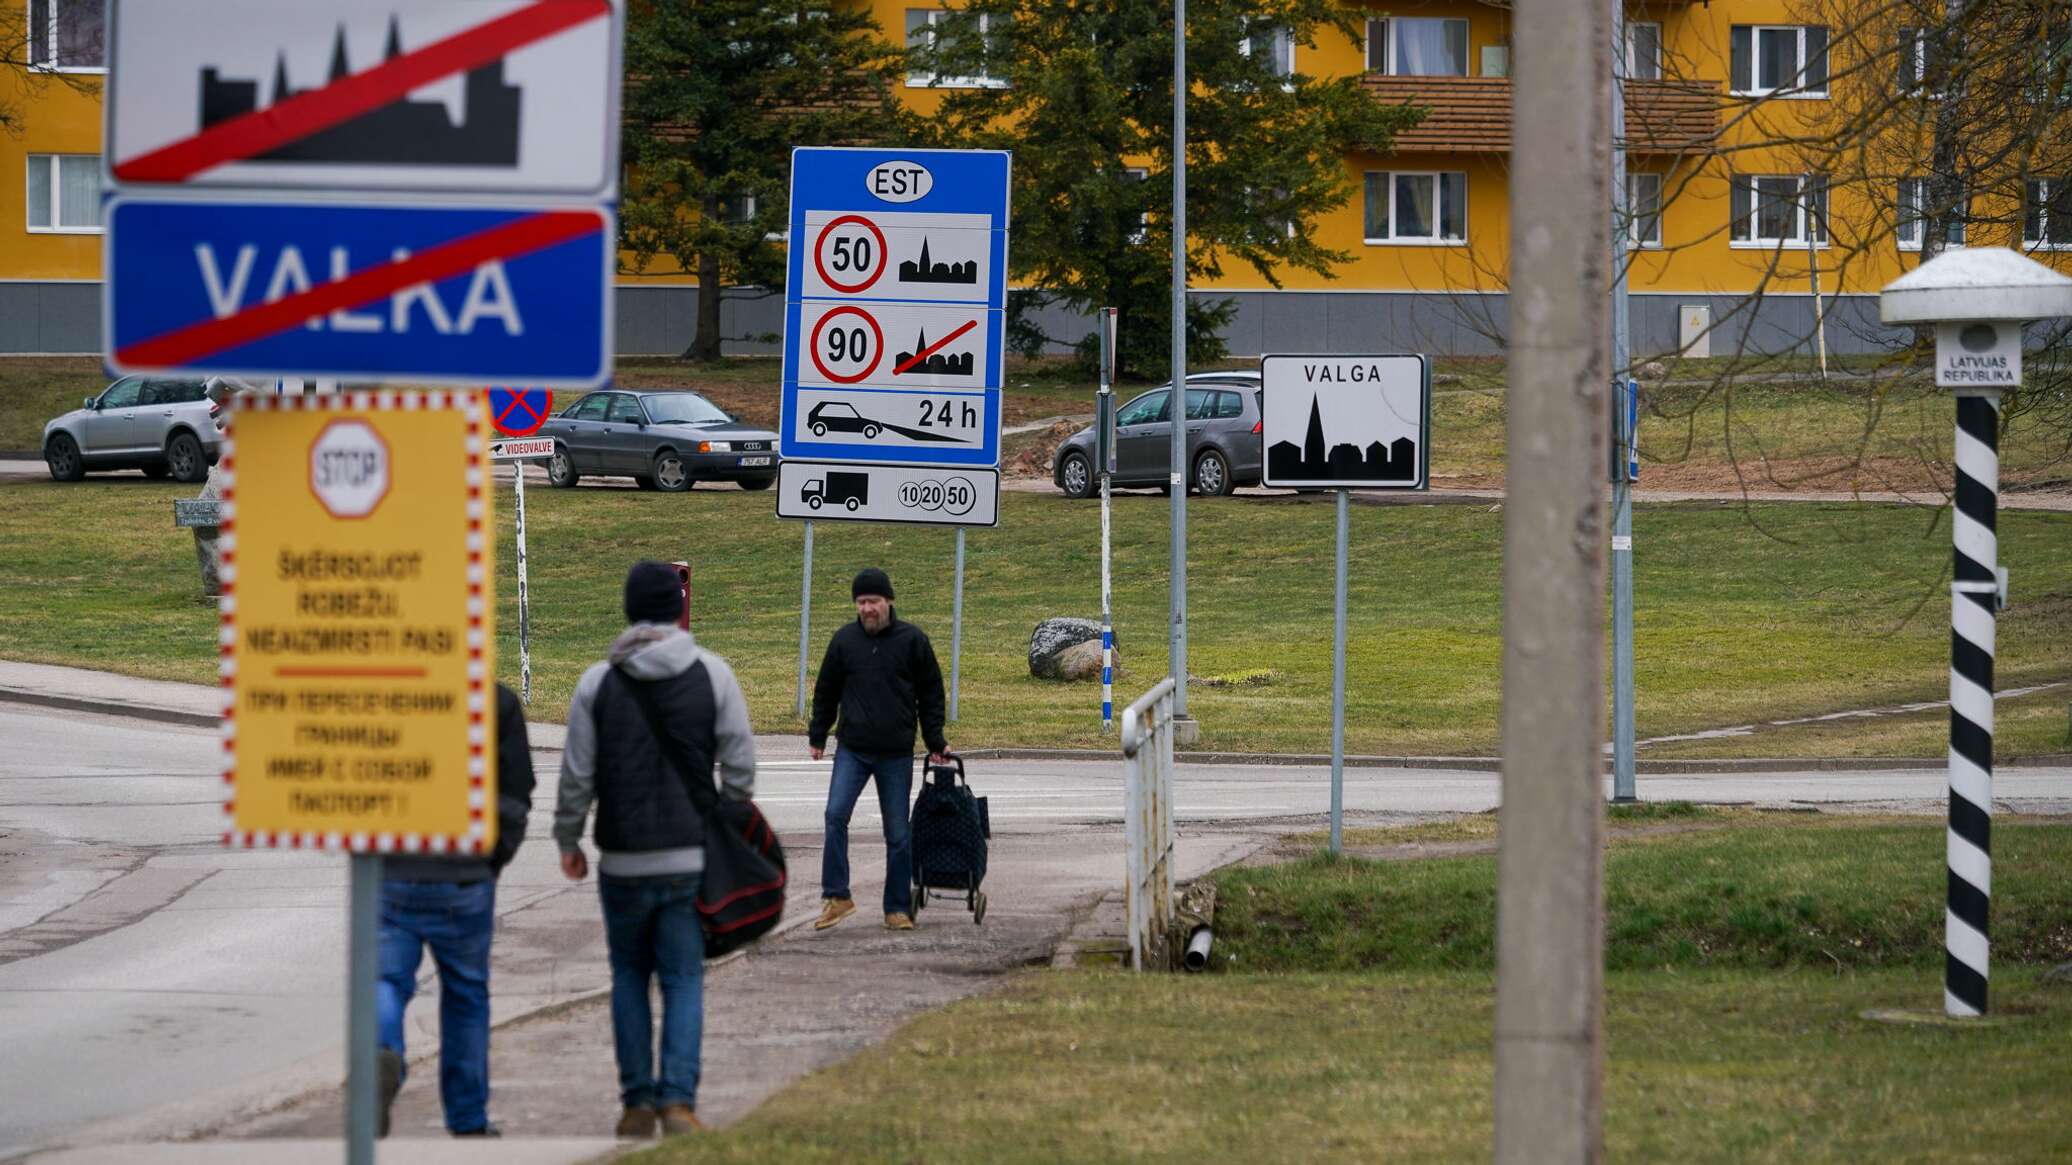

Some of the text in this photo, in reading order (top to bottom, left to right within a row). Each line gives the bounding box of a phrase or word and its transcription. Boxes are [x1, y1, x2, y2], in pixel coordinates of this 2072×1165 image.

[875, 168, 924, 195] EST
[832, 236, 872, 273] 50
[194, 243, 524, 335] VALKA
[827, 326, 868, 363] 90
[1304, 364, 1382, 383] VALGA
[1943, 370, 2014, 382] REPUBLIKA
[1949, 356, 2008, 369] LATVIJAS
[918, 399, 977, 429] 24 h
[505, 441, 552, 455] VIDEOVALVE
[315, 449, 377, 487] STOP
[902, 486, 968, 505] 10 20 50
